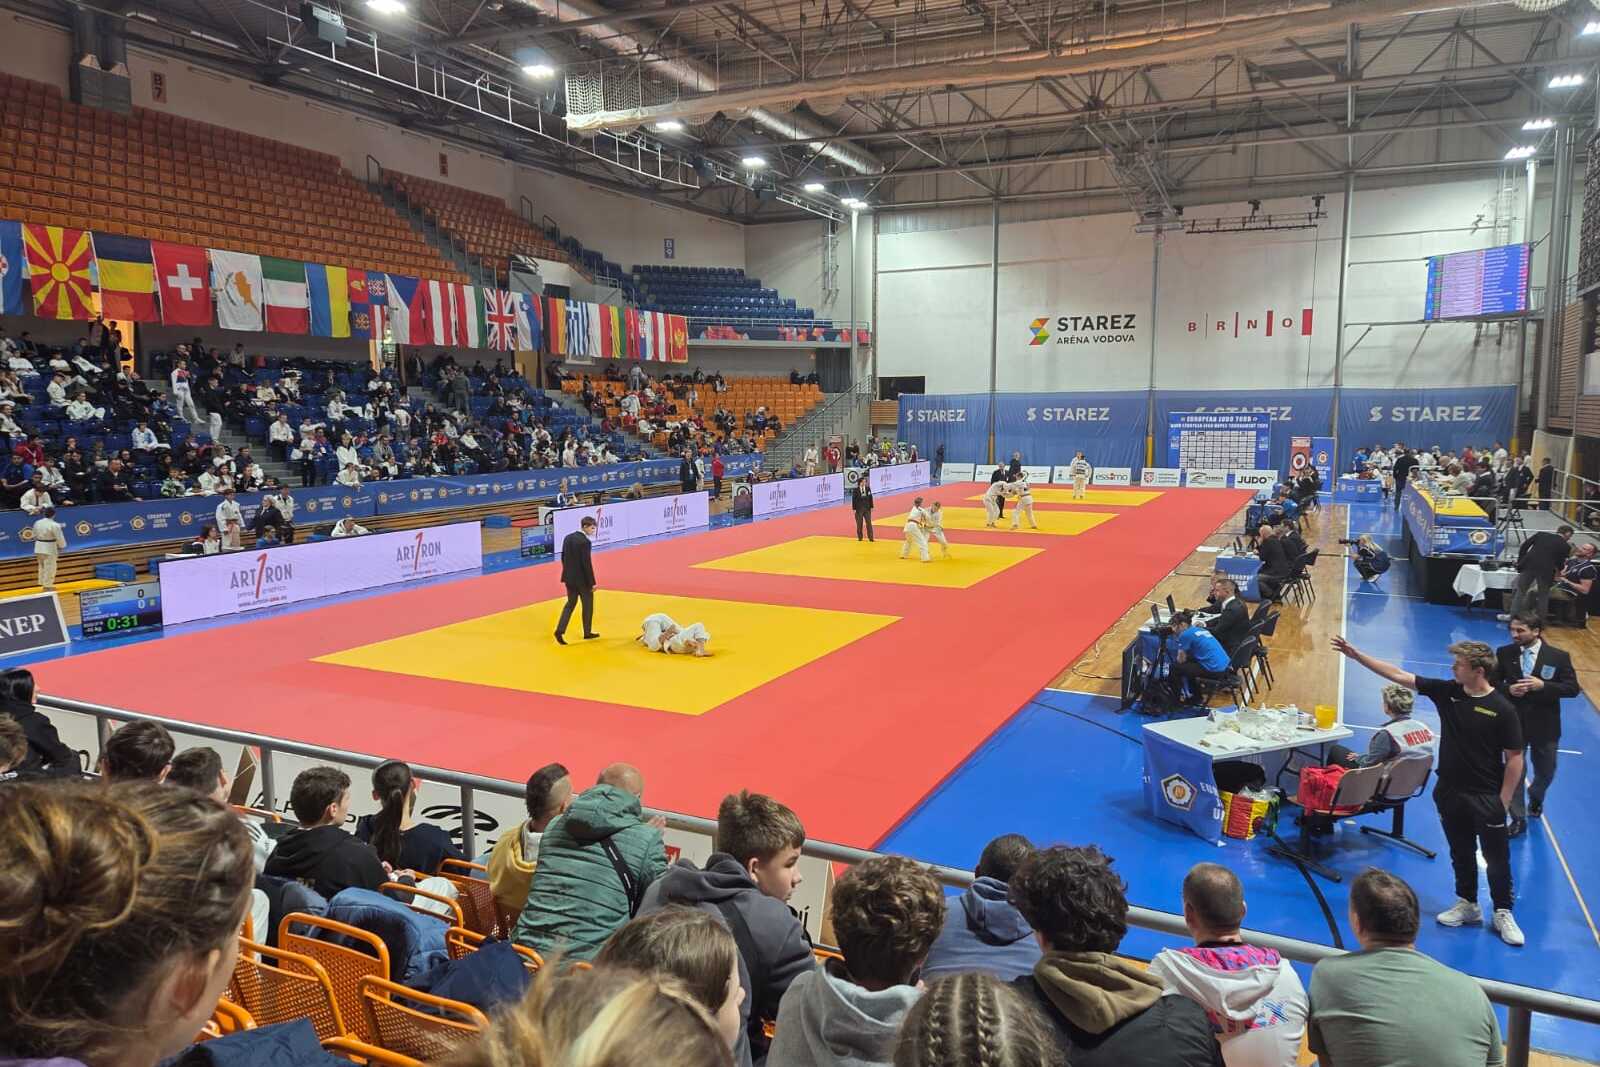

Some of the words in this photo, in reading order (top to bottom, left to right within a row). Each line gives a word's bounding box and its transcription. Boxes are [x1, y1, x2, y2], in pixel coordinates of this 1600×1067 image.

[1057, 314, 1136, 331] STAREZ
[1093, 334, 1135, 343] VODOVA
[918, 409, 966, 422] STAREZ
[1042, 408, 1110, 421] STAREZ
[1392, 406, 1483, 422] STAREZ
[1237, 476, 1267, 484] JUDO
[137, 589, 145, 598] 0
[137, 599, 146, 609] 0
[107, 614, 139, 631] 0:31
